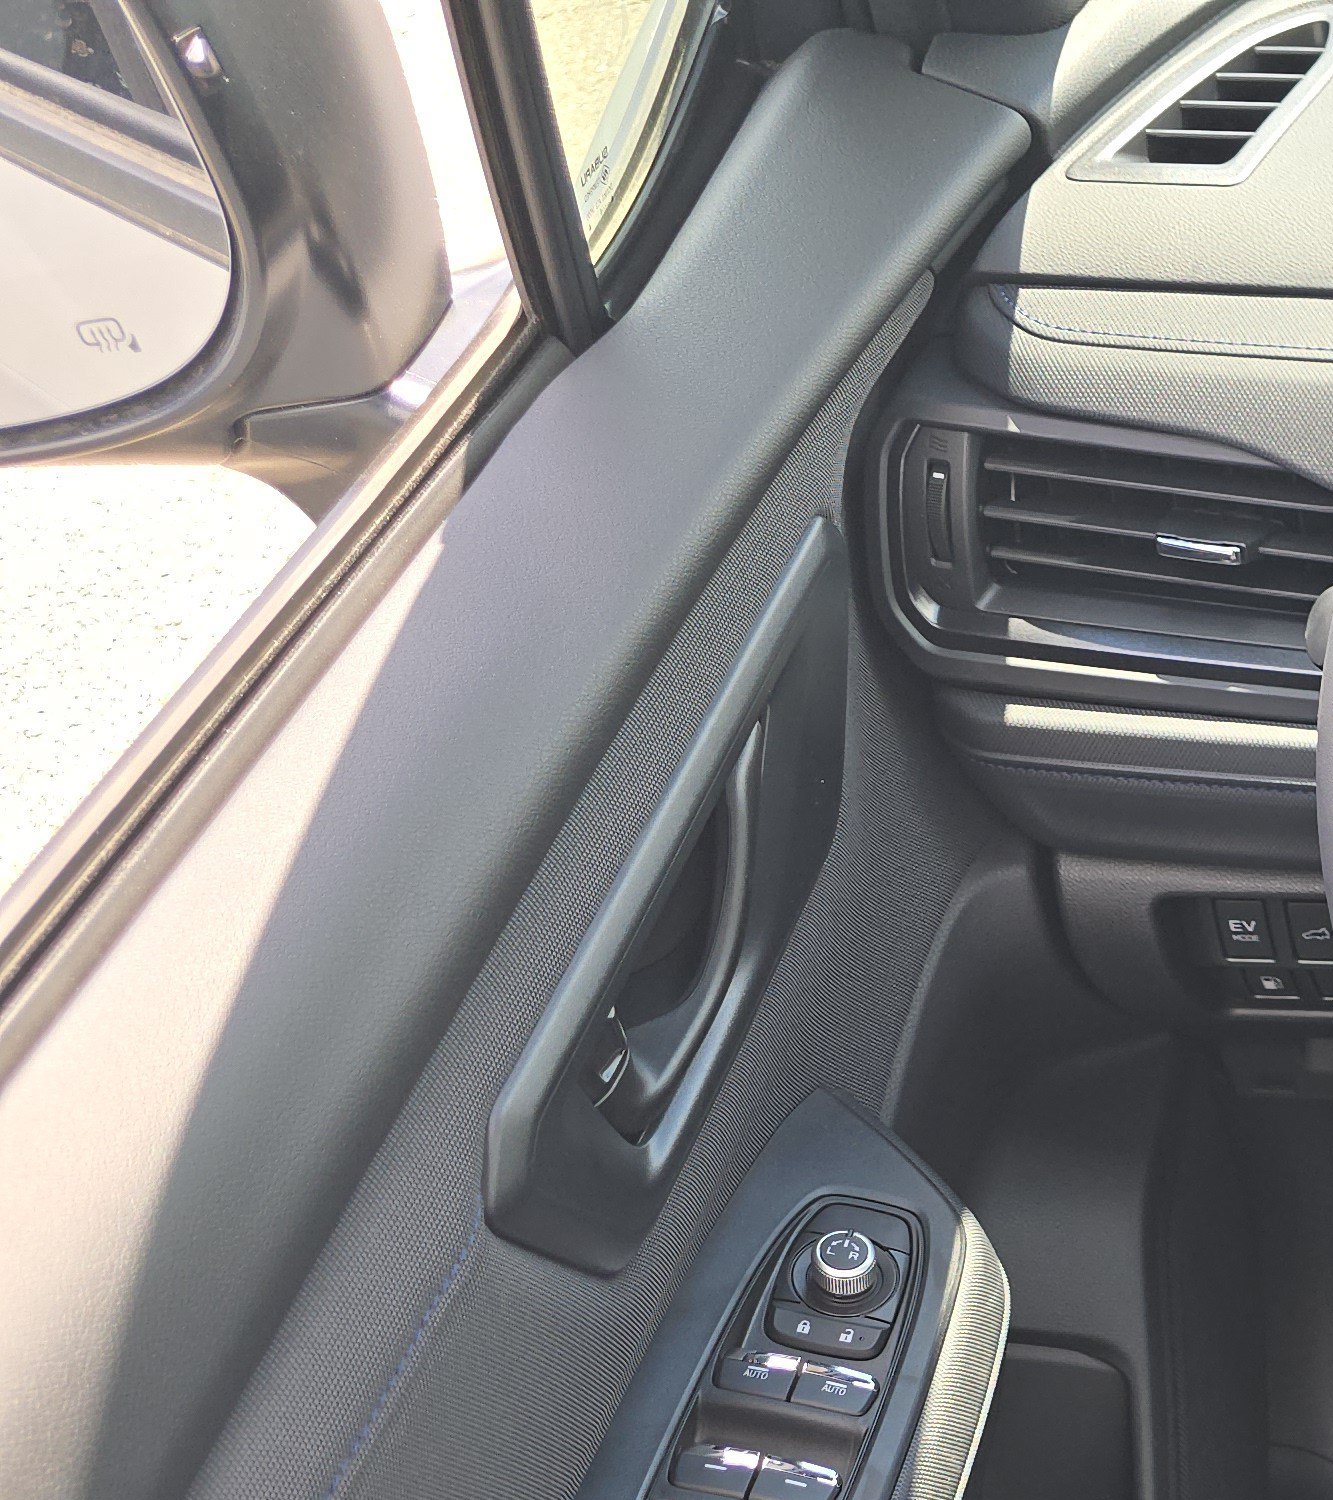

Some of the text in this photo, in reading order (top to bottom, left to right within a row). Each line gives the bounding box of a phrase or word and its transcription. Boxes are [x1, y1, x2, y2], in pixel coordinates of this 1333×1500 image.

[1228, 919, 1257, 932] EV
[848, 1251, 860, 1261] R
[743, 1367, 769, 1381] AUTO
[821, 1383, 847, 1397] AUTO
